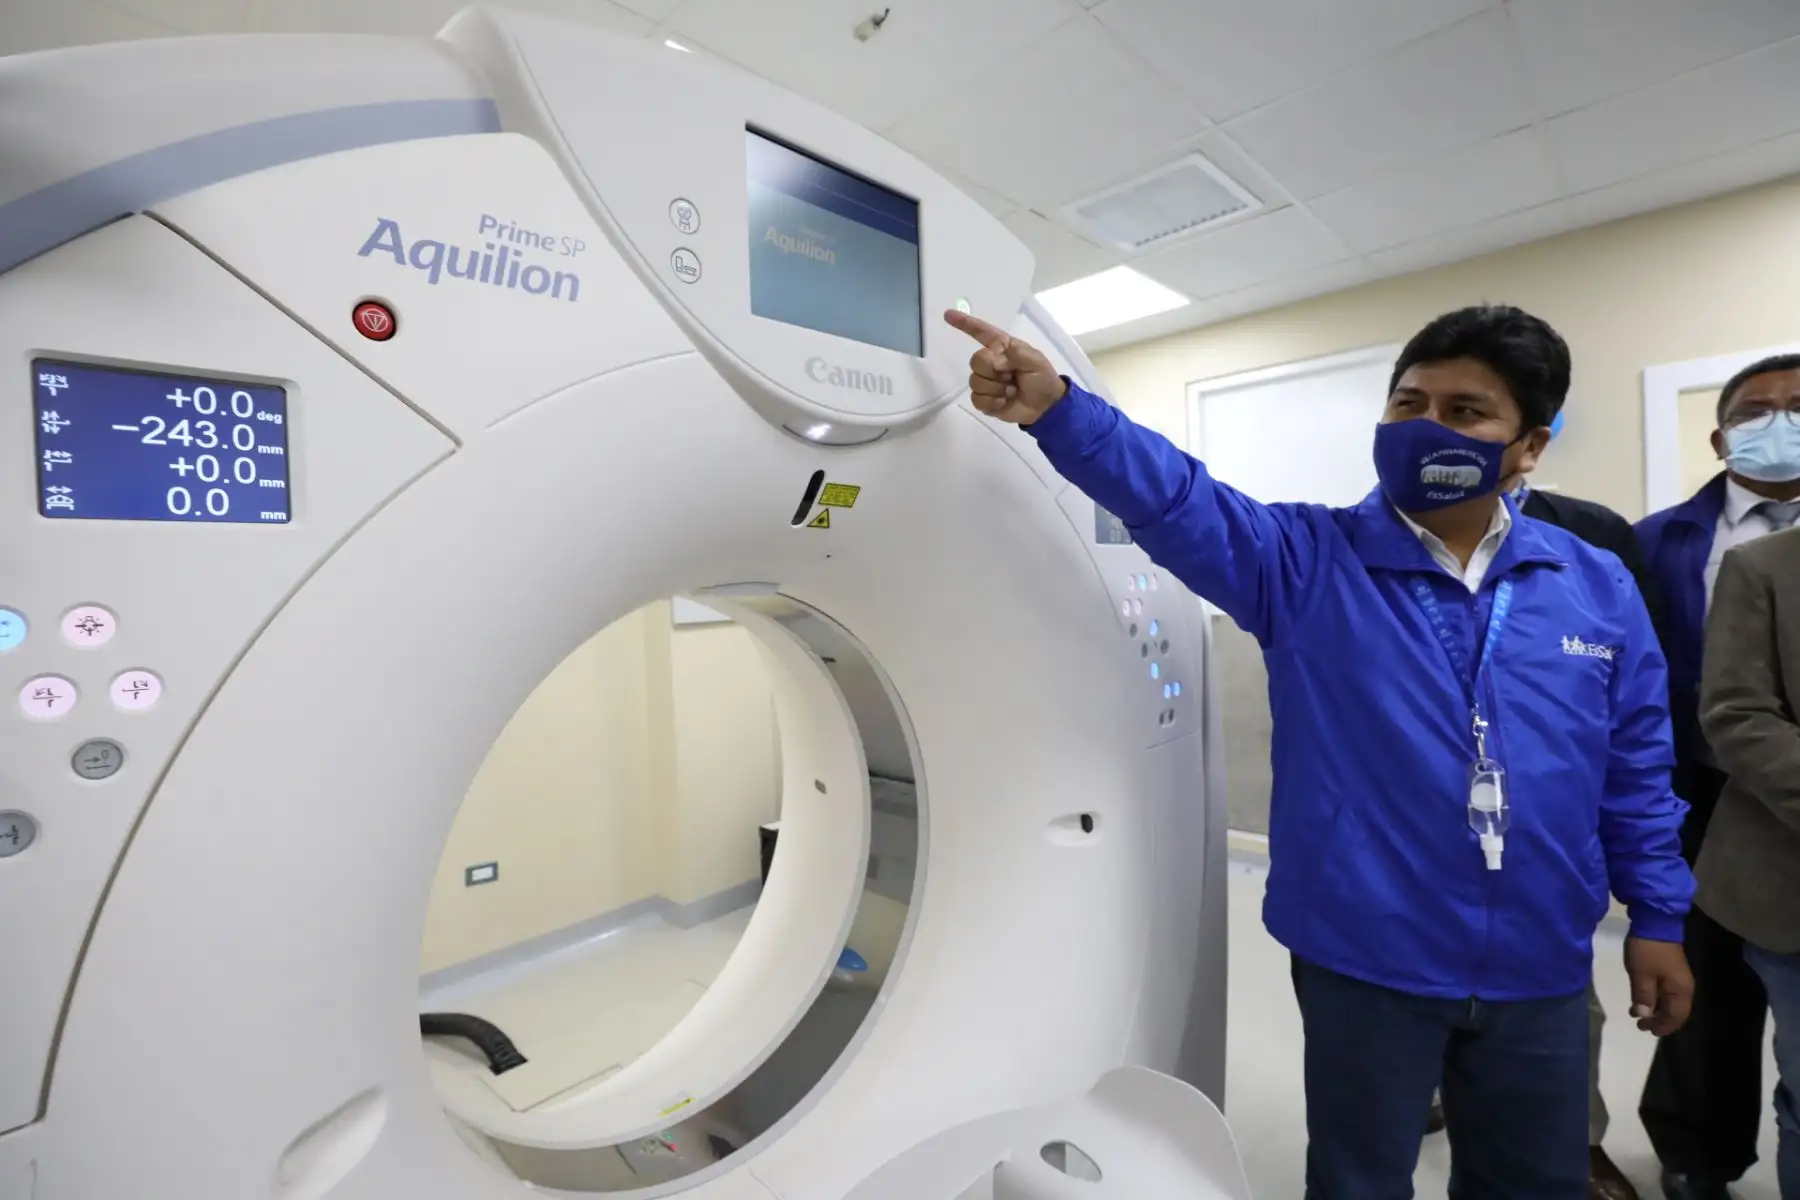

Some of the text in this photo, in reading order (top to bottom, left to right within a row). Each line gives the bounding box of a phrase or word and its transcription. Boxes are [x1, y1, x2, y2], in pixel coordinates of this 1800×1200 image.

[478, 213, 586, 258] Prime SP
[764, 226, 835, 265] Aquilion
[357, 216, 580, 303] Aquilion
[804, 356, 893, 396] Canon
[166, 386, 283, 424] +0.0 deg
[112, 416, 284, 455] -243.0 mm
[169, 454, 285, 488] +0.0 mm
[166, 486, 286, 520] 0.0 mm
